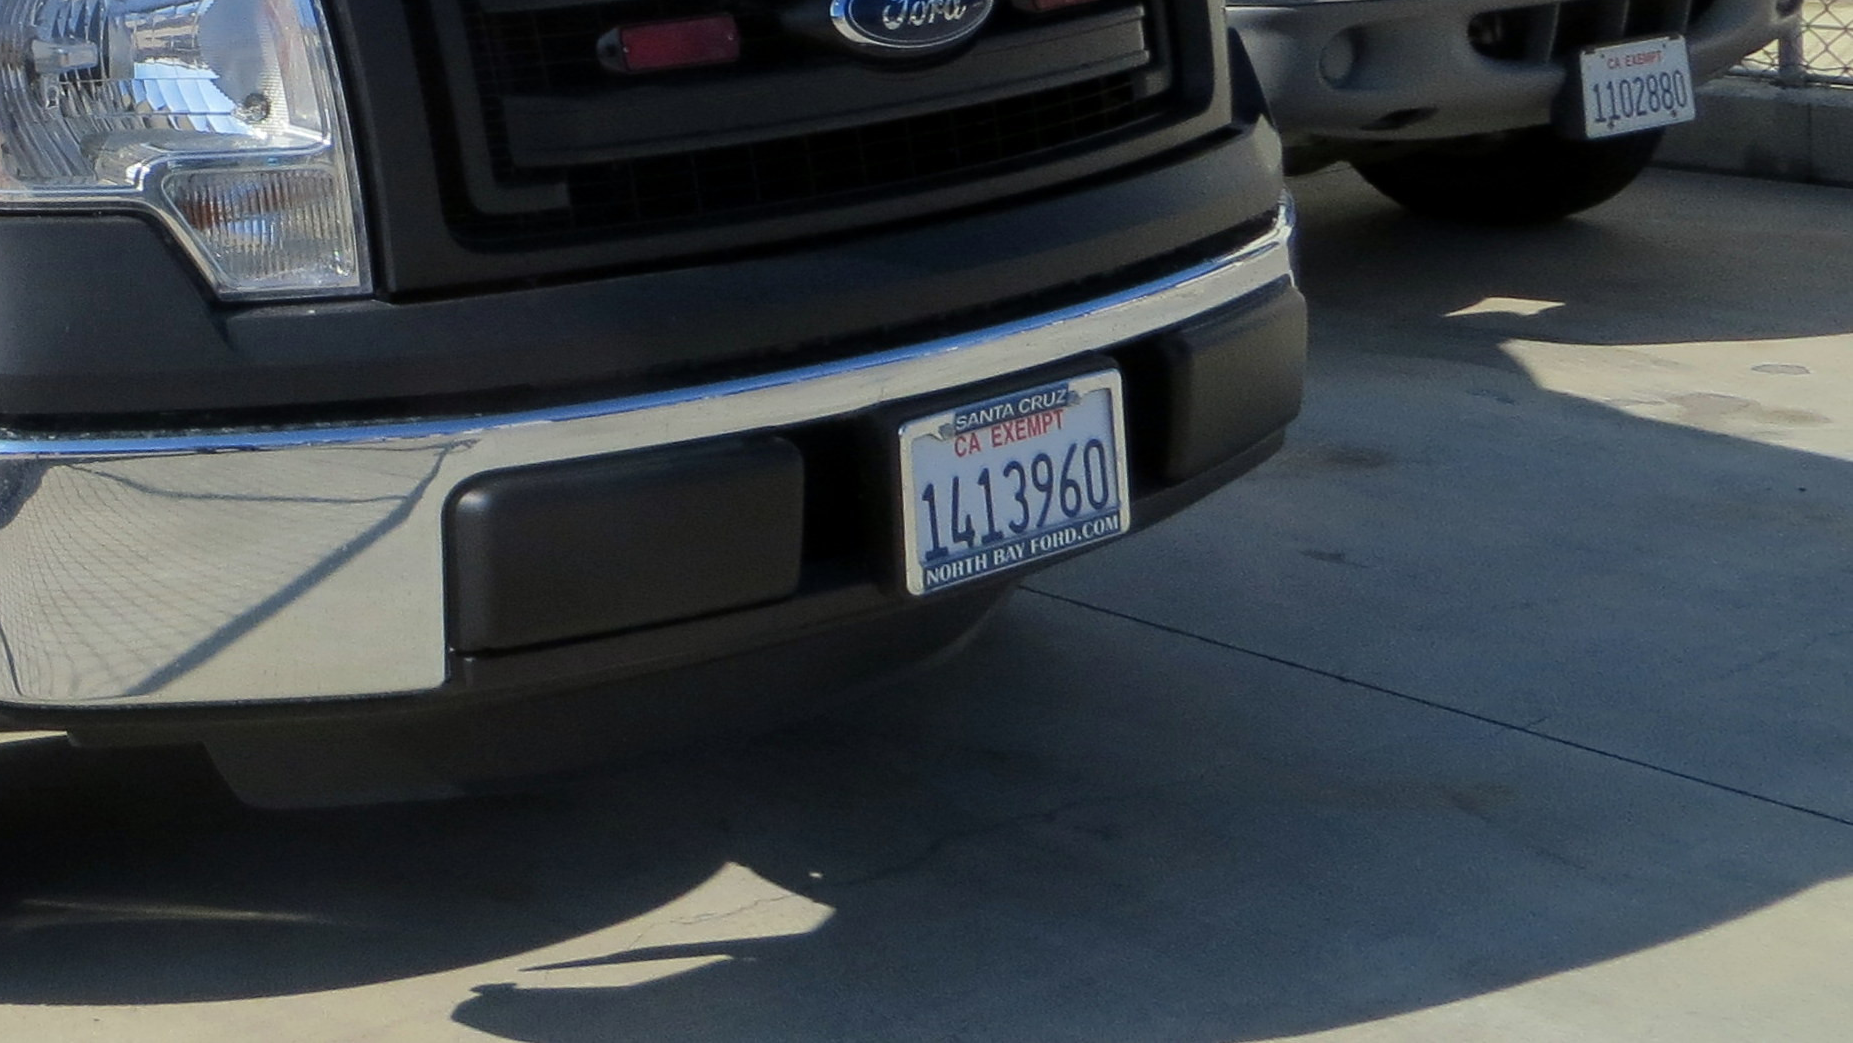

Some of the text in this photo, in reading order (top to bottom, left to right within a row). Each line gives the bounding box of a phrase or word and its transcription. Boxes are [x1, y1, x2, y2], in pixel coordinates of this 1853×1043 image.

[1607, 57, 1621, 70] CA
[1593, 69, 1688, 123] 1102880
[954, 409, 1065, 458] CA EXEMPT
[955, 389, 1068, 431] SANTA CRUZ
[921, 438, 1109, 562] 1413960
[926, 514, 1119, 585] NORTH BAY FORD.COM
